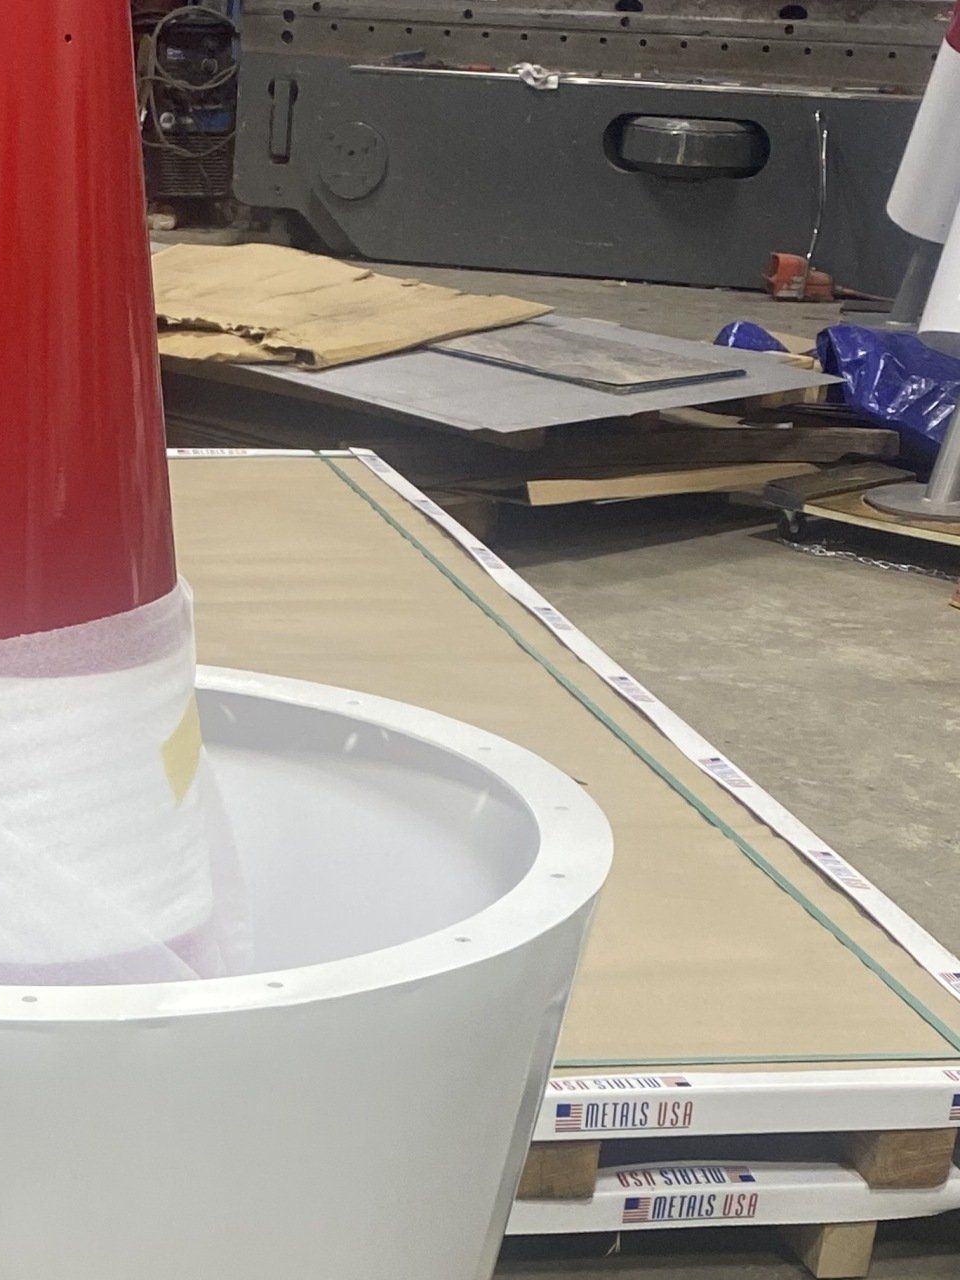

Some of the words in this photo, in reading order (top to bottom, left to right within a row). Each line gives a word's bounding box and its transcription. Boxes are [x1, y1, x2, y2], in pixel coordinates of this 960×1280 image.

[585, 1101, 650, 1128] METALS
[657, 1101, 693, 1127] USA
[616, 1170, 656, 1188] USA
[659, 1167, 726, 1186] METALS
[651, 1194, 717, 1219] METALS
[722, 1193, 759, 1217] USA
